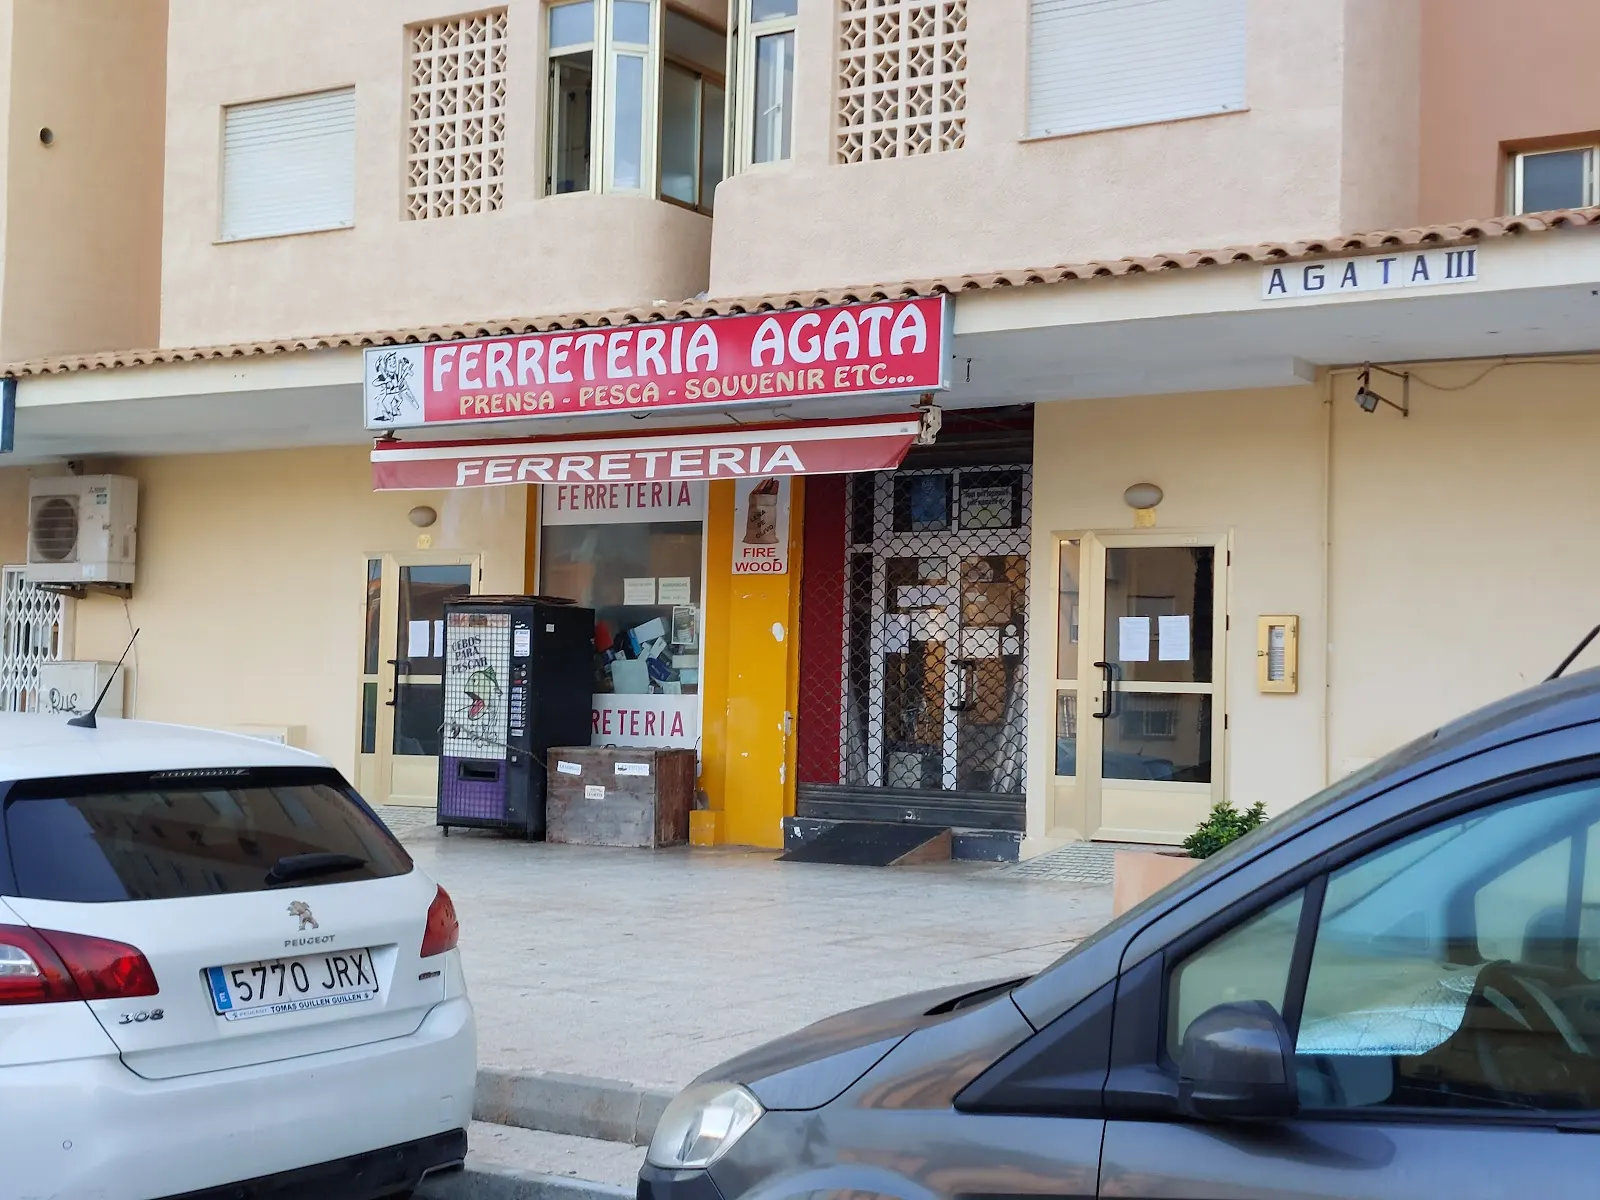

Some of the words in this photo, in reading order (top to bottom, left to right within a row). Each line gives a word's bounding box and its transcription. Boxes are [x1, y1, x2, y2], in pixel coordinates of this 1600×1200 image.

[1267, 254, 1430, 295] AGATA
[1444, 249, 1476, 279] III
[432, 323, 719, 392] FERRETERIA
[750, 303, 928, 367] AGATA
[459, 389, 555, 415] PRENSA
[579, 381, 660, 407] PESCA
[684, 368, 825, 400] SOUVENIR
[834, 363, 914, 388] ETC...
[455, 445, 806, 487] FERRETERIA
[557, 480, 691, 510] FERRETERIA
[743, 547, 776, 558] FIRE
[735, 561, 783, 572] WOOD
[451, 634, 482, 651] CEBOS
[455, 645, 480, 661] PARA
[452, 656, 488, 675] PESCAR
[284, 934, 336, 948] PEUGEOT
[231, 961, 310, 1003] 5770
[322, 954, 370, 990] JRX
[218, 992, 227, 1003] E
[270, 1002, 298, 1014] TOMAS
[298, 998, 331, 1010] GUILLEN
[331, 993, 362, 1005] GUILLEN
[118, 1008, 164, 1025] 308
